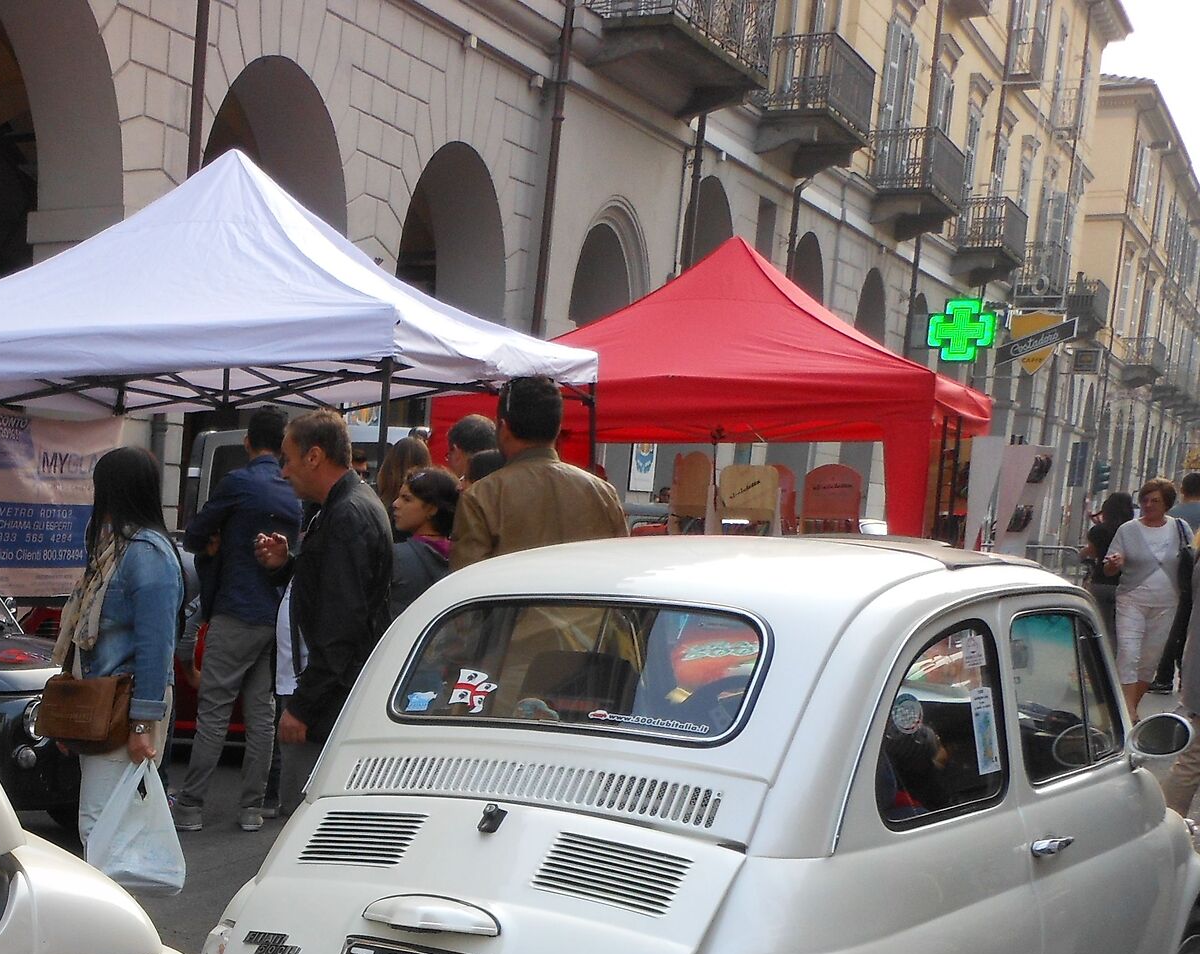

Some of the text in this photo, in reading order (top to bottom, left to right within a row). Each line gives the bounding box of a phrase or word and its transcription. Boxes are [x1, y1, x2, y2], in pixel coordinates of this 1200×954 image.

[0, 507, 73, 519] VETRO ROTTO?
[45, 522, 73, 531] ESPERTI
[15, 549, 41, 561] Clienti
[608, 713, 709, 734] www.500clubitalia.it
